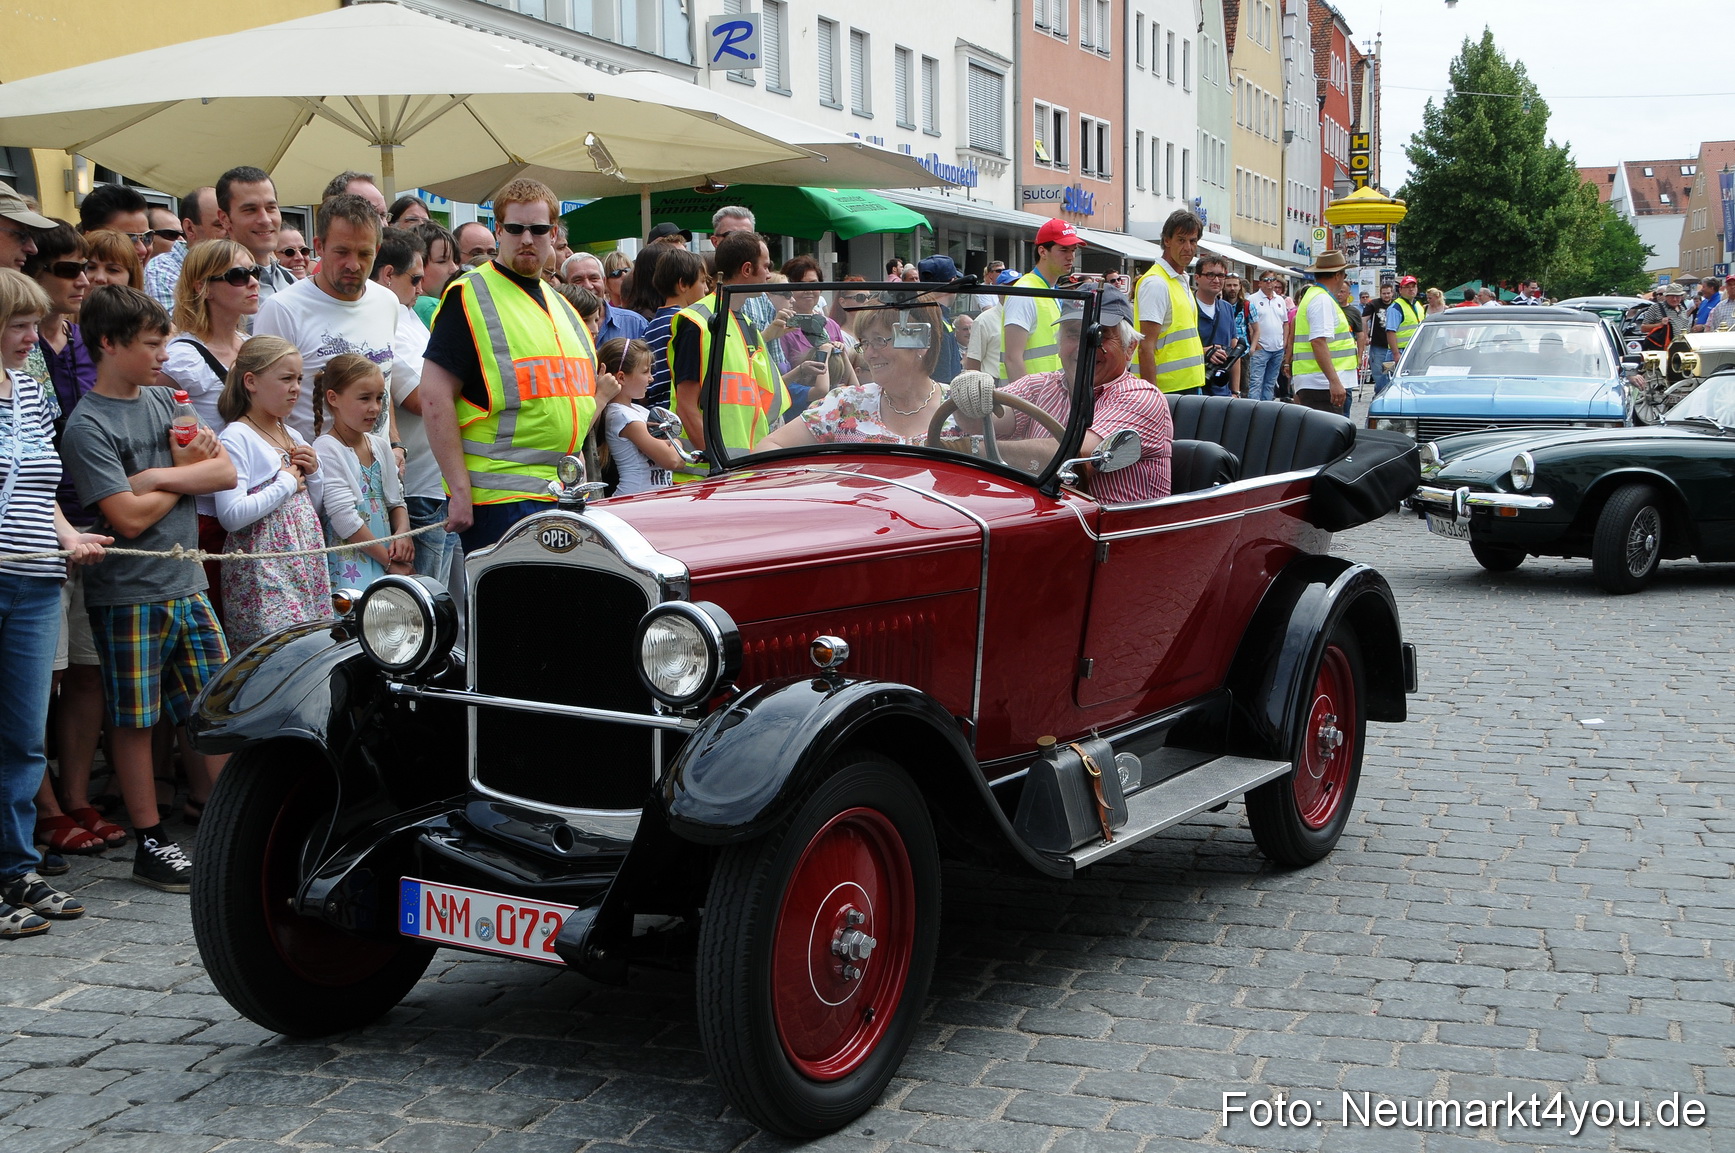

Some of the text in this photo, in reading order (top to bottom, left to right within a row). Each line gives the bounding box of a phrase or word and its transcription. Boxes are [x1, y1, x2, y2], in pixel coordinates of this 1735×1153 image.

[712, 20, 756, 63] R.
[932, 152, 978, 188] Rupprecht
[659, 195, 745, 205] Neumarkter
[1023, 187, 1061, 200] sutor.
[516, 359, 590, 395] THW
[542, 530, 572, 547] OPEL
[407, 912, 415, 925] D
[426, 890, 471, 938] NM
